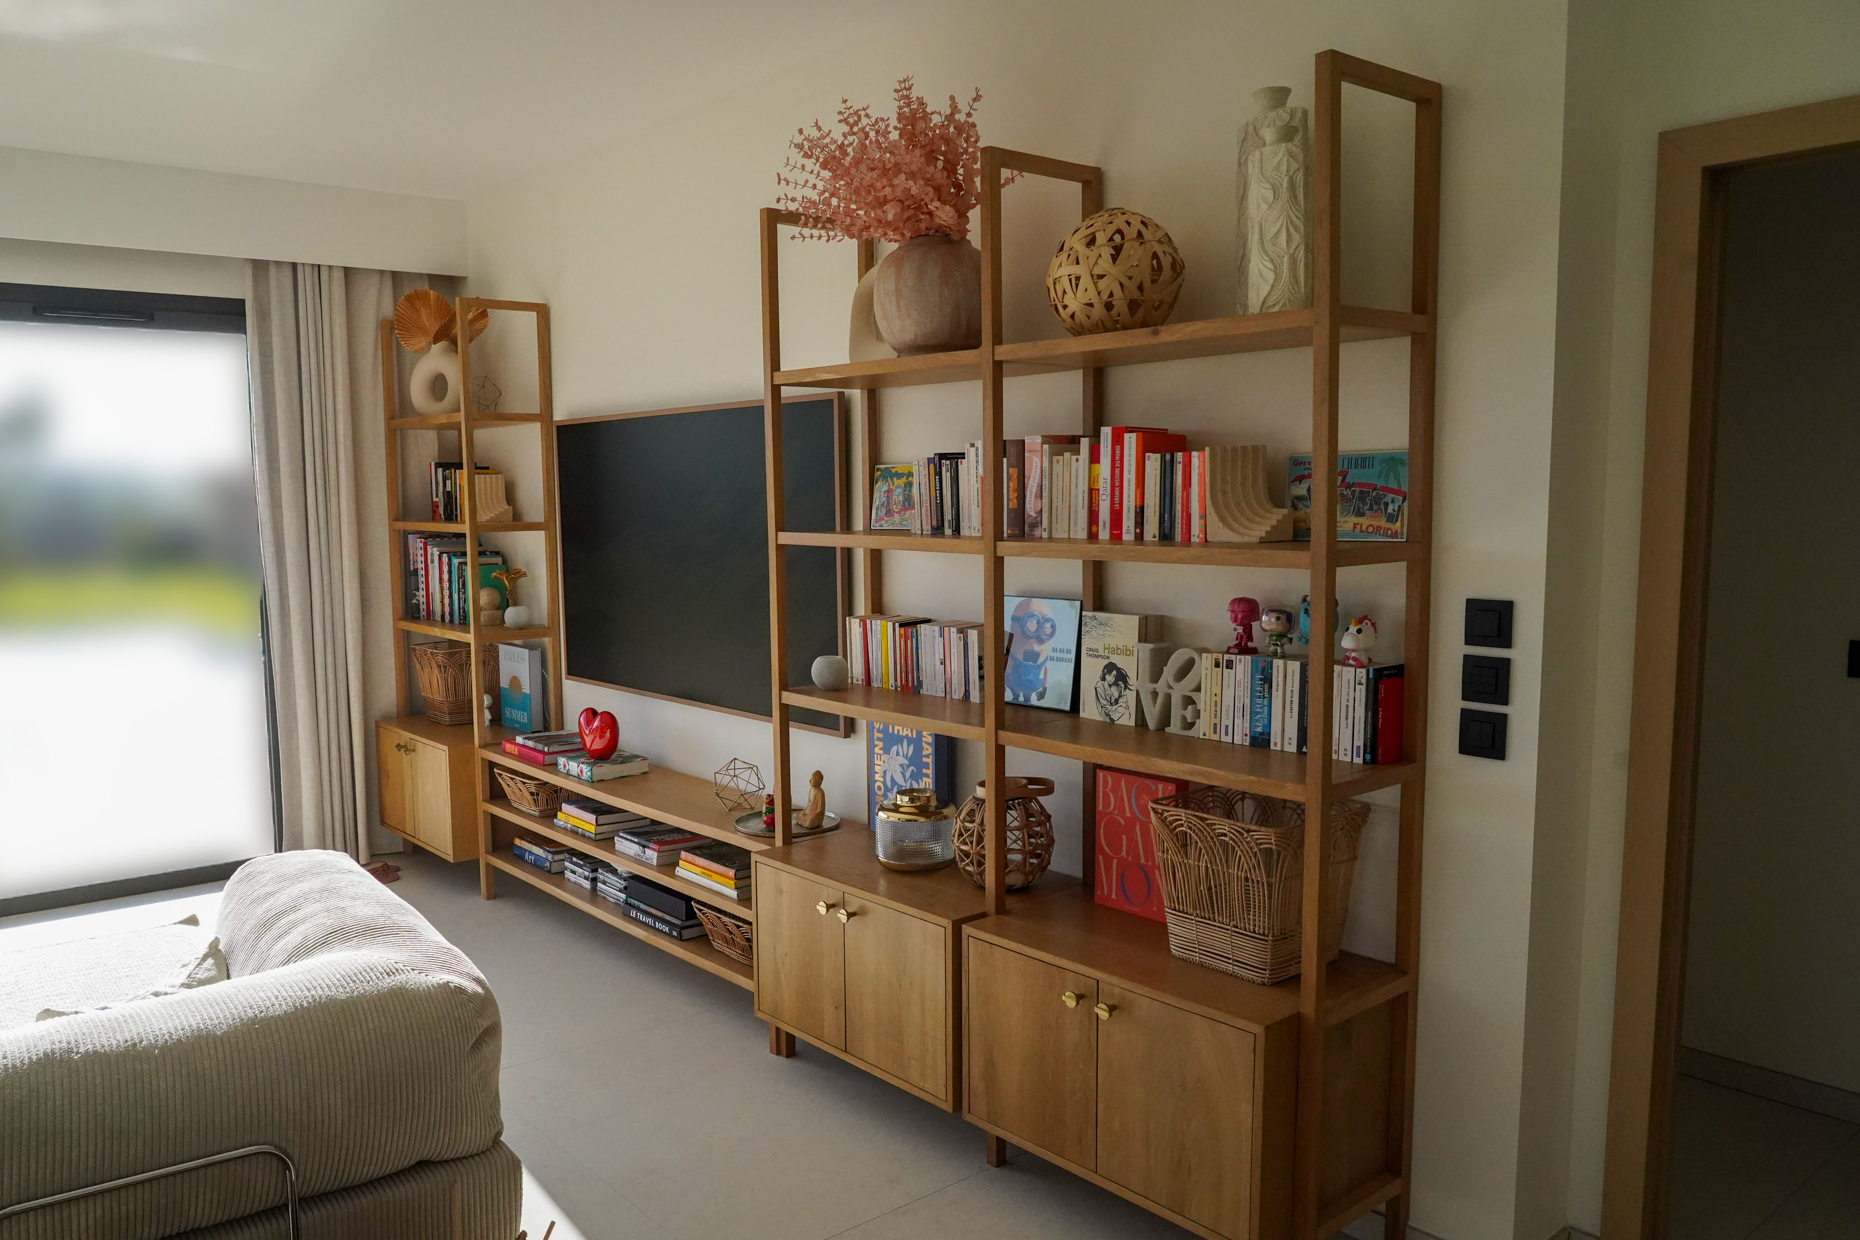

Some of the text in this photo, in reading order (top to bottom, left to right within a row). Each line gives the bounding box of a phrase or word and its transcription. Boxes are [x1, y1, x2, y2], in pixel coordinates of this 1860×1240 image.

[1100, 476, 1108, 502] Qatar
[1352, 522, 1398, 538] FLORIDA
[504, 650, 526, 663] ENDLESS
[1103, 643, 1134, 657] Habibi
[1254, 675, 1264, 732] KEN FOLLETT
[504, 707, 528, 723] SUMMER
[888, 724, 916, 738] THAT
[922, 731, 932, 789] MATTE
[524, 851, 535, 865] Art
[630, 910, 636, 918] LE
[637, 912, 654, 926] TRAVEL
[656, 922, 670, 934] BOOK
